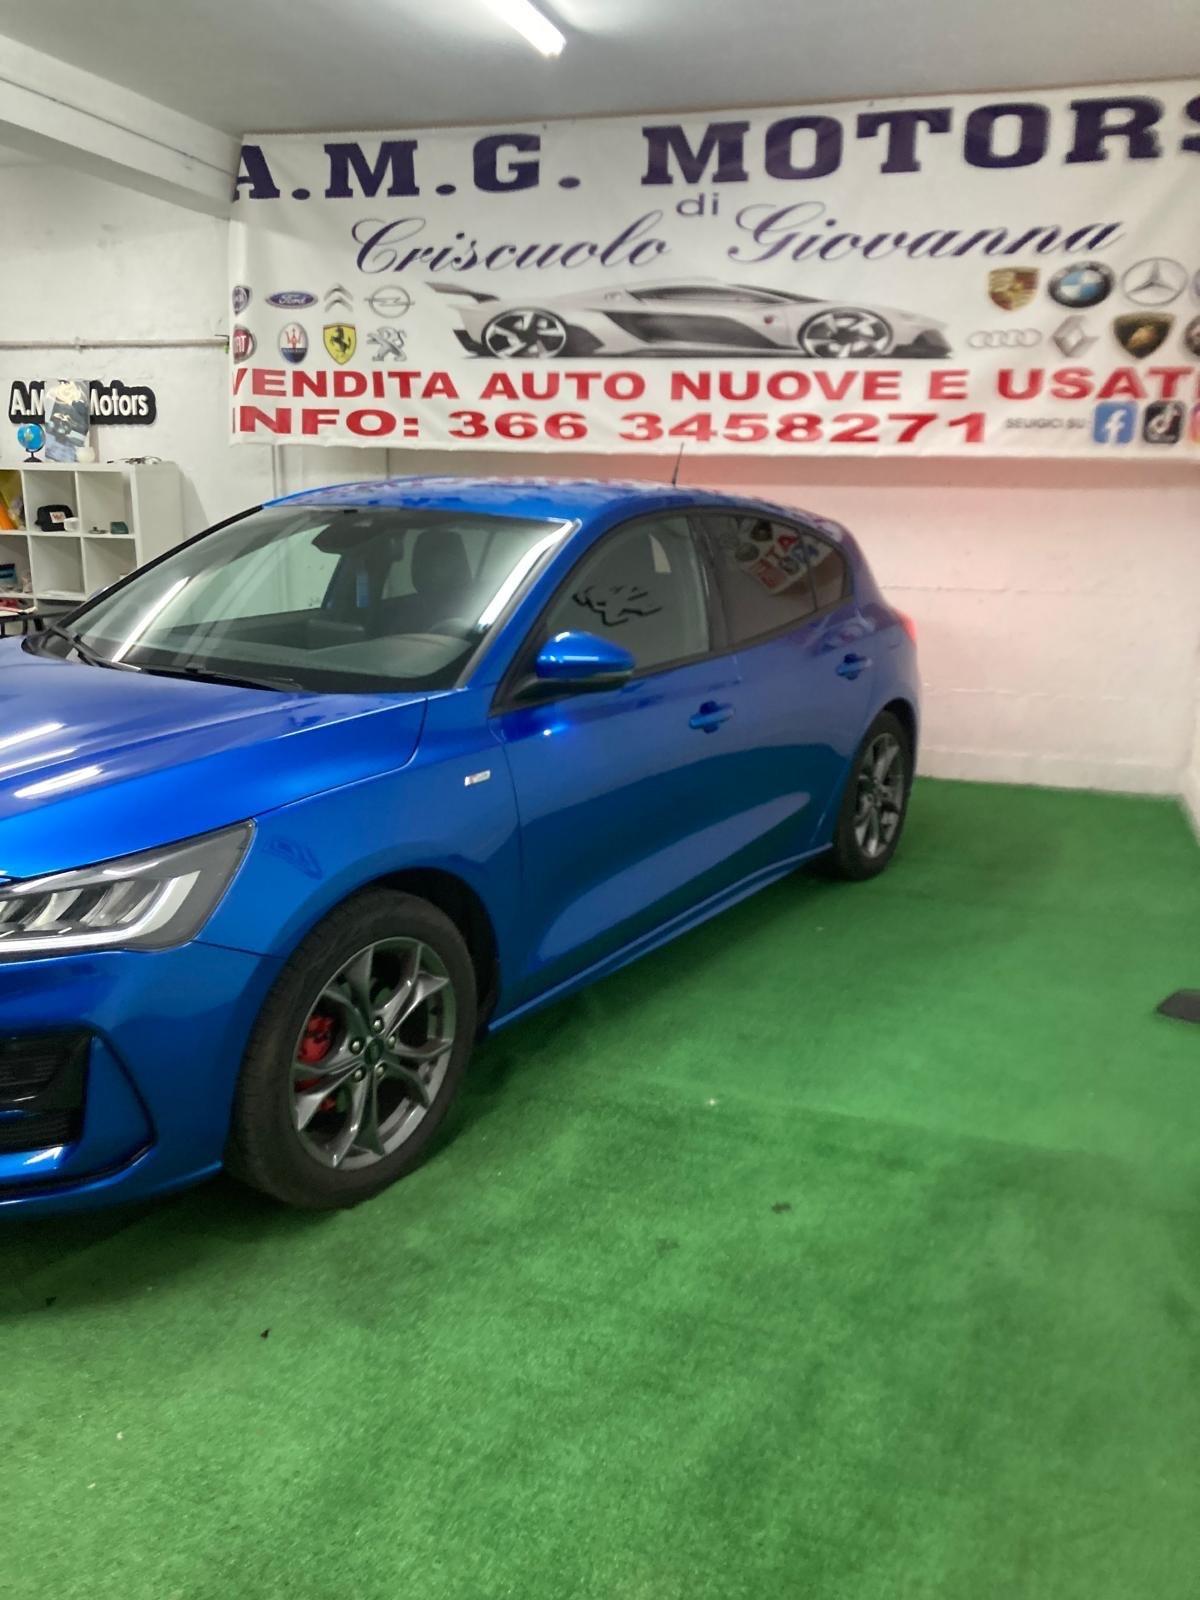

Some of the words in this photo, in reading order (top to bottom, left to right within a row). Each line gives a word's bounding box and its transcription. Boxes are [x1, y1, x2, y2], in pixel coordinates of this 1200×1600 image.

[641, 95, 1200, 186] MOTOR
[676, 192, 719, 216] di
[351, 209, 672, 274] Criscuolo
[727, 201, 1125, 263] Giovanna
[480, 370, 646, 401] AUTO
[671, 370, 901, 402] NUOVE
[928, 370, 969, 400] E
[997, 366, 1200, 401] USAT
[232, 405, 419, 438] NFO:
[448, 411, 588, 440] 366
[618, 412, 986, 443] 3458271
